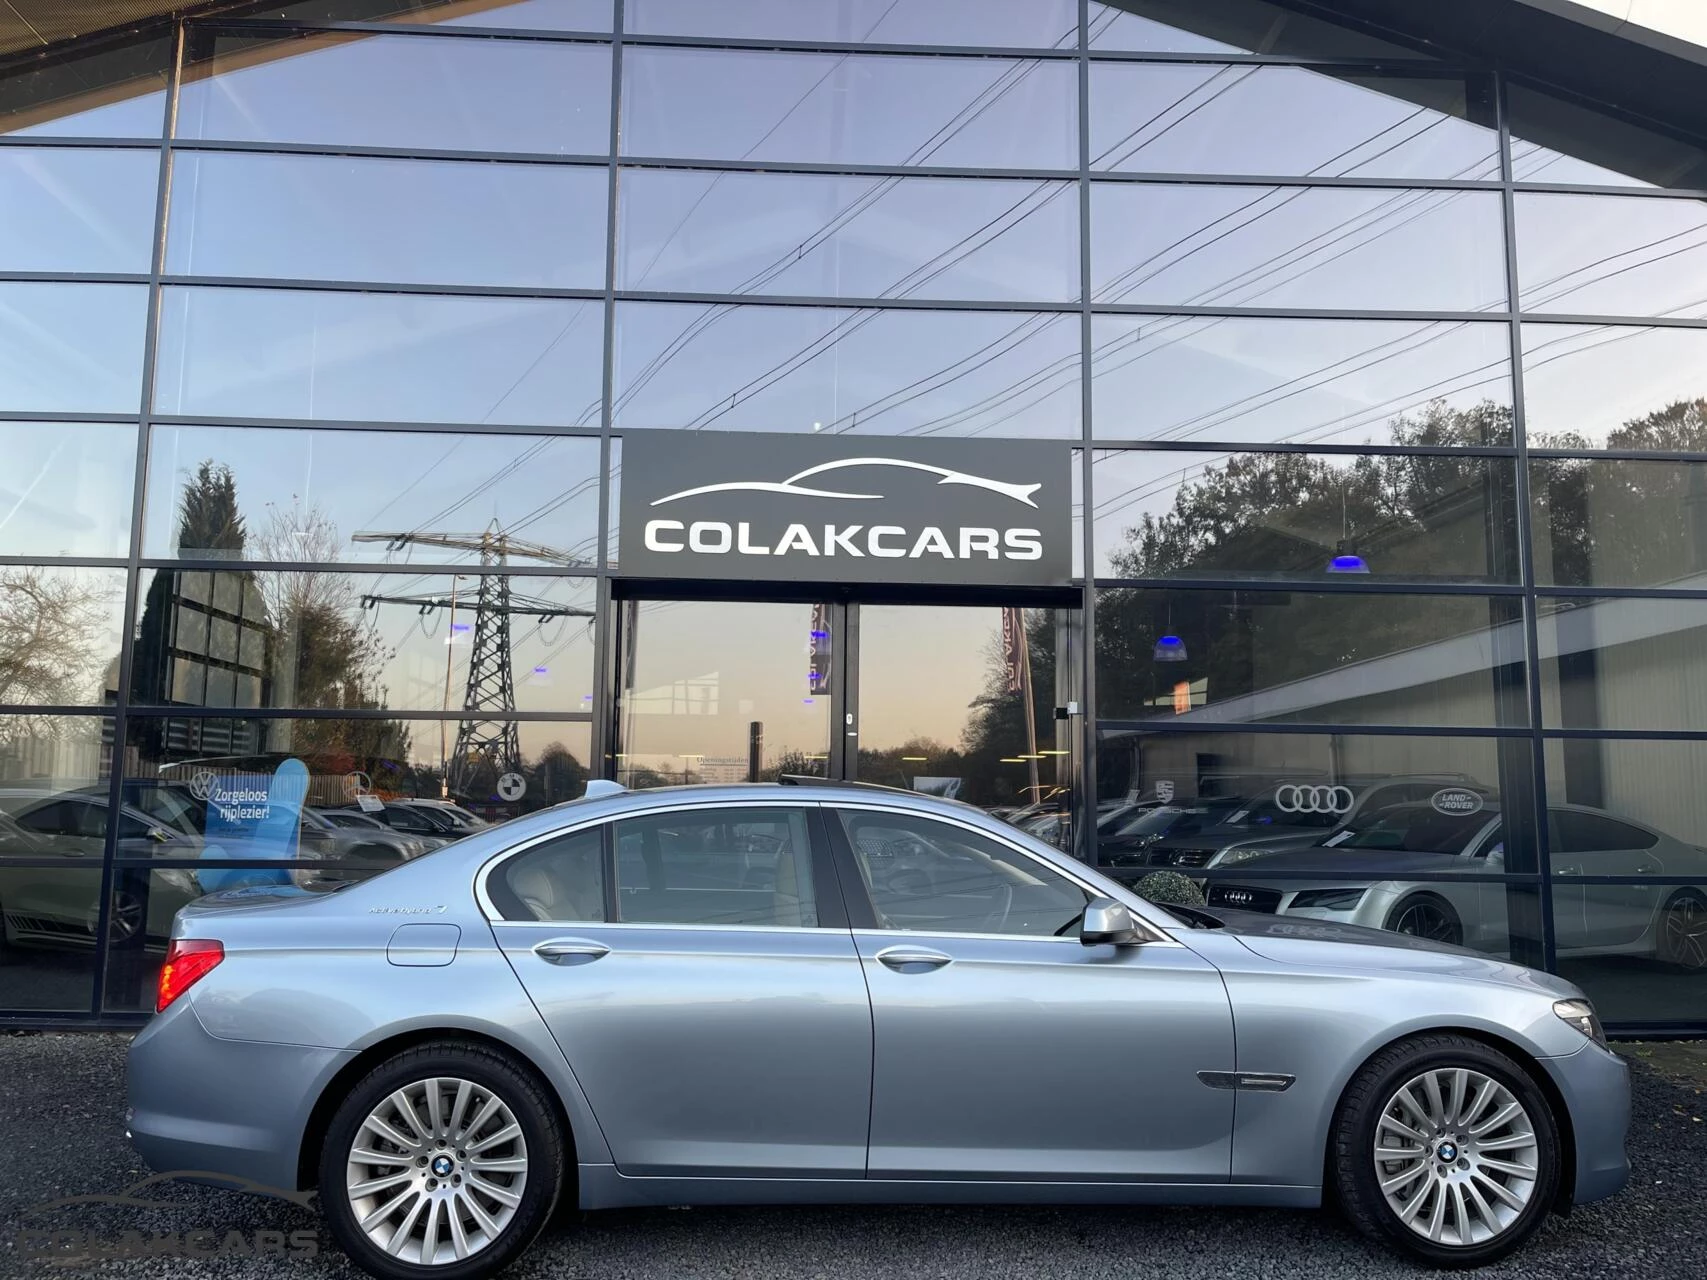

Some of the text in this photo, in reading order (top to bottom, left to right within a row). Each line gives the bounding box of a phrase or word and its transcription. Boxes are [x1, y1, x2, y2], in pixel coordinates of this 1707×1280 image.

[644, 519, 1043, 561] COLAKCARS
[214, 788, 268, 805] Zorgeloos
[220, 805, 270, 822] rijplezier!
